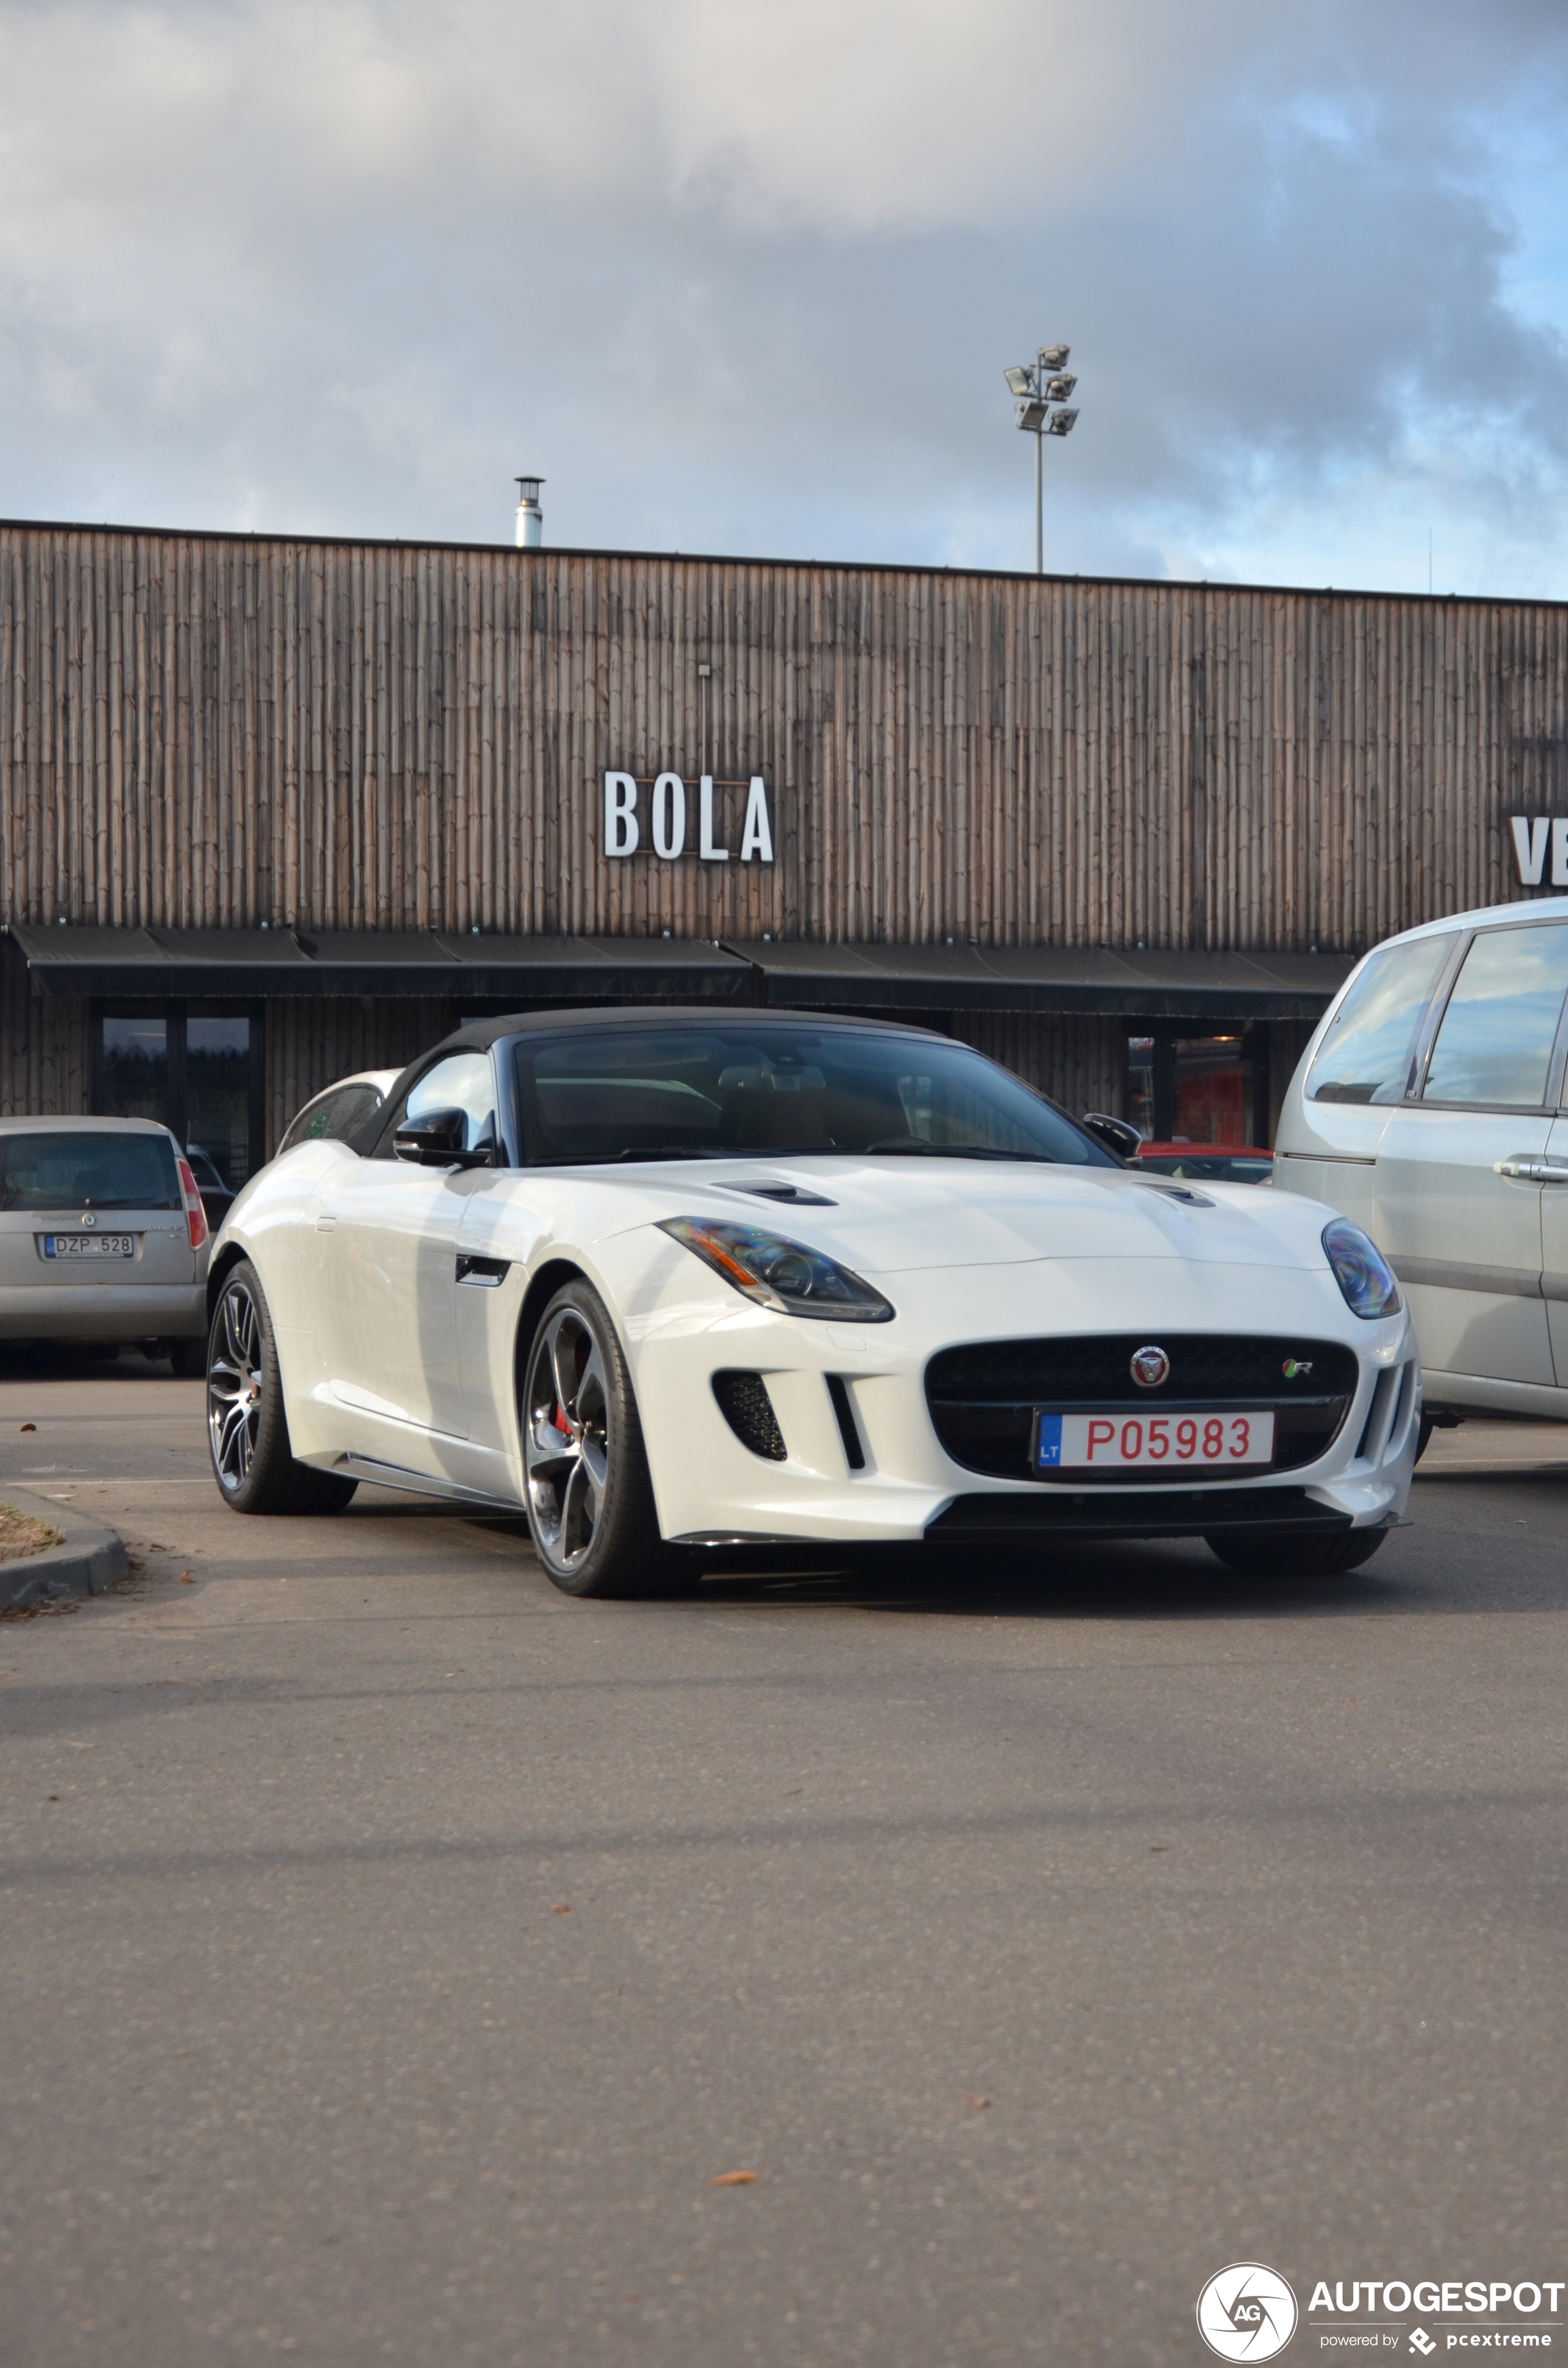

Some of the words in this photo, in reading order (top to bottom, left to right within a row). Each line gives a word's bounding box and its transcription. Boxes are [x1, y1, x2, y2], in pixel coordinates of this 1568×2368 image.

[604, 771, 774, 861] BOLA
[56, 1238, 90, 1252] DZP
[101, 1238, 130, 1252] 528
[1135, 1345, 1167, 1358] JAGUAR
[1293, 1362, 1313, 1374] R
[1086, 1418, 1249, 1460] P05983
[1041, 1446, 1059, 1457] LT
